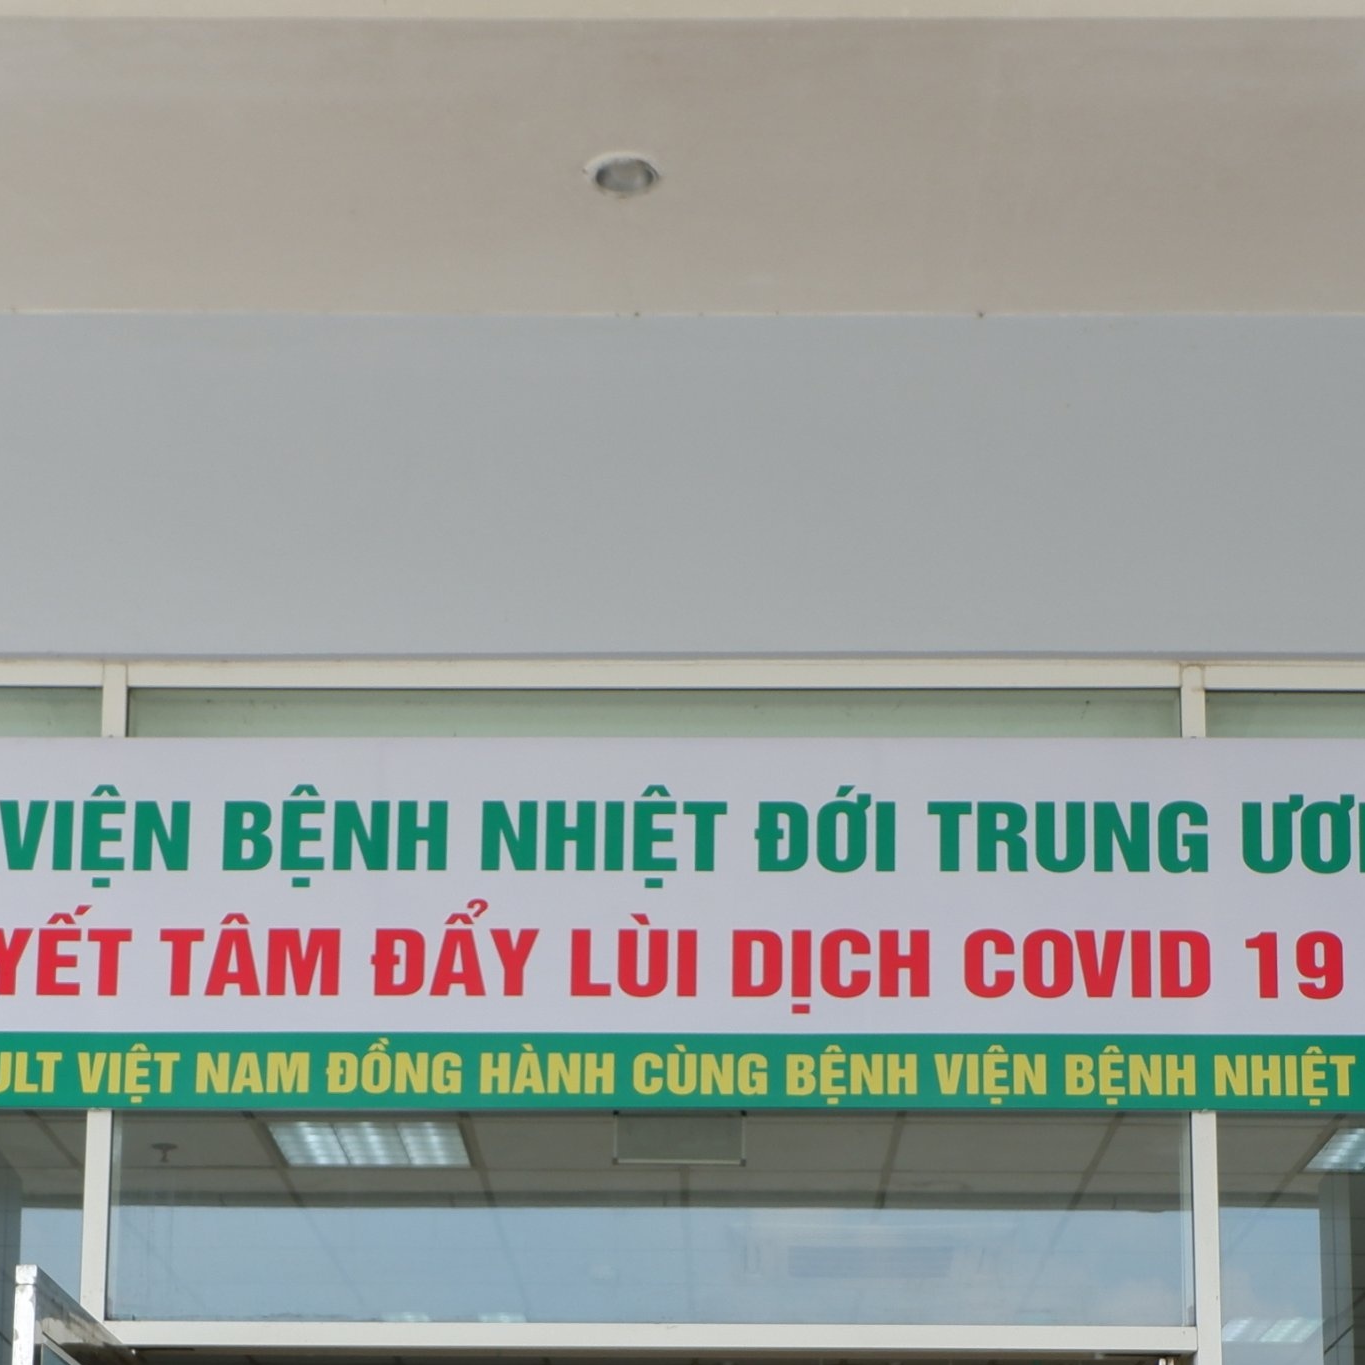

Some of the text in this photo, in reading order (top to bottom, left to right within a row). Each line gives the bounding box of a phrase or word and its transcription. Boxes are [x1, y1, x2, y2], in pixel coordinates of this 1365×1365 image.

[221, 783, 450, 889] BỆNH
[480, 783, 729, 890] NHIỆT
[753, 784, 897, 874] ĐỚI
[926, 799, 1210, 875] TRUNG
[158, 911, 343, 998] TÂM
[369, 897, 540, 998] ĐẨY
[569, 912, 699, 999] LÙI
[730, 927, 932, 1016] DỊCH
[962, 927, 1213, 1000] COVID
[1244, 929, 1346, 1001] 19
[78, 1044, 179, 1103] VIỆT
[196, 1052, 309, 1093] NAM
[327, 1038, 461, 1094] ĐỒNG
[480, 1044, 615, 1094] HÀNH
[633, 1044, 768, 1095] CÙNG
[786, 1045, 917, 1104] BỆNH
[935, 1044, 1047, 1105] VIỆN
[1065, 1045, 1196, 1105] BỆNH
[1214, 1046, 1355, 1106] NHIỆT
